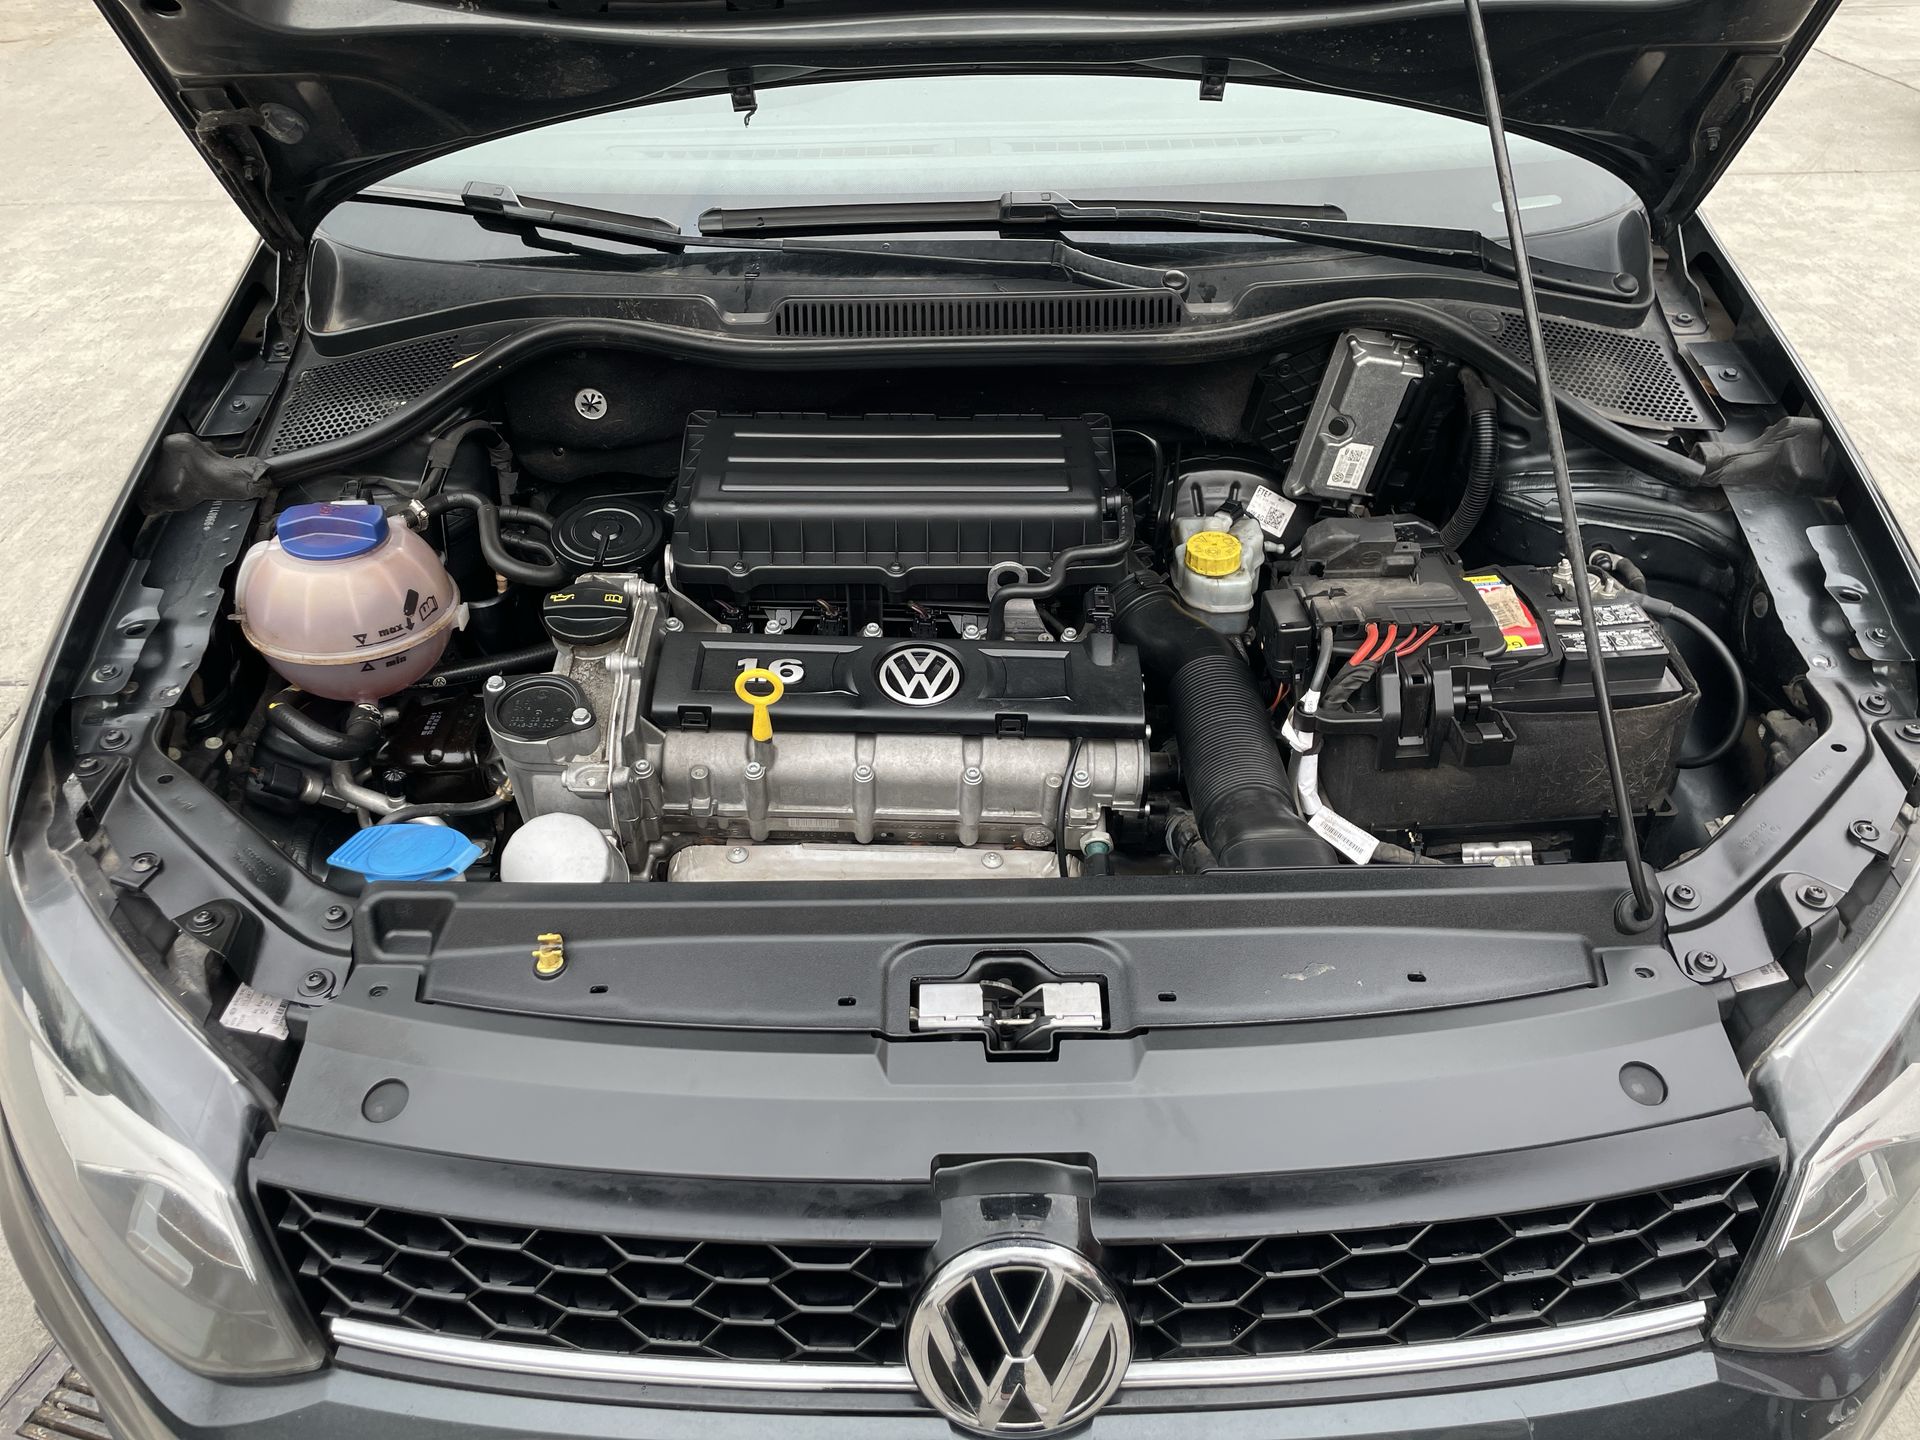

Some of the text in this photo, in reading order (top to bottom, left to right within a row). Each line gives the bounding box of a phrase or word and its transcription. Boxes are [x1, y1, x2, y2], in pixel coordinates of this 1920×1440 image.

[378, 624, 404, 637] max
[386, 656, 406, 667] min
[880, 648, 960, 705] VW
[912, 1248, 1124, 1430] VW
